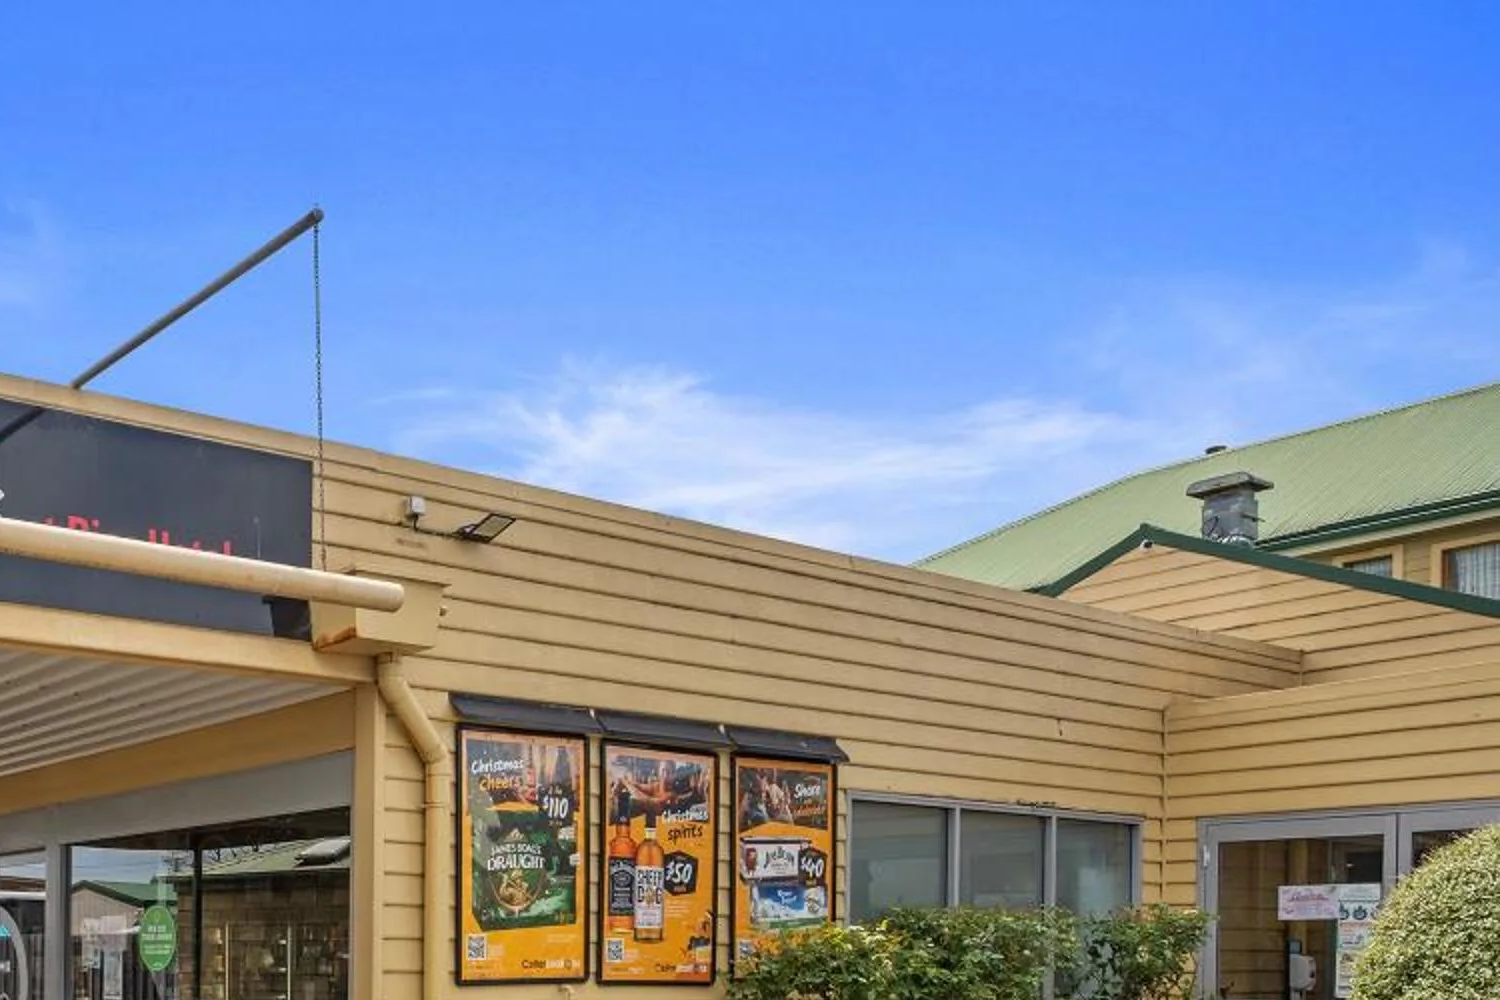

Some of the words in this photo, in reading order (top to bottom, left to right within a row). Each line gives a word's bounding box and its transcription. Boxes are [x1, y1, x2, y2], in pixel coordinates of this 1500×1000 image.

[668, 823, 703, 845] spirits
[487, 852, 547, 871] DRAUGHT
[665, 861, 693, 884] $50
